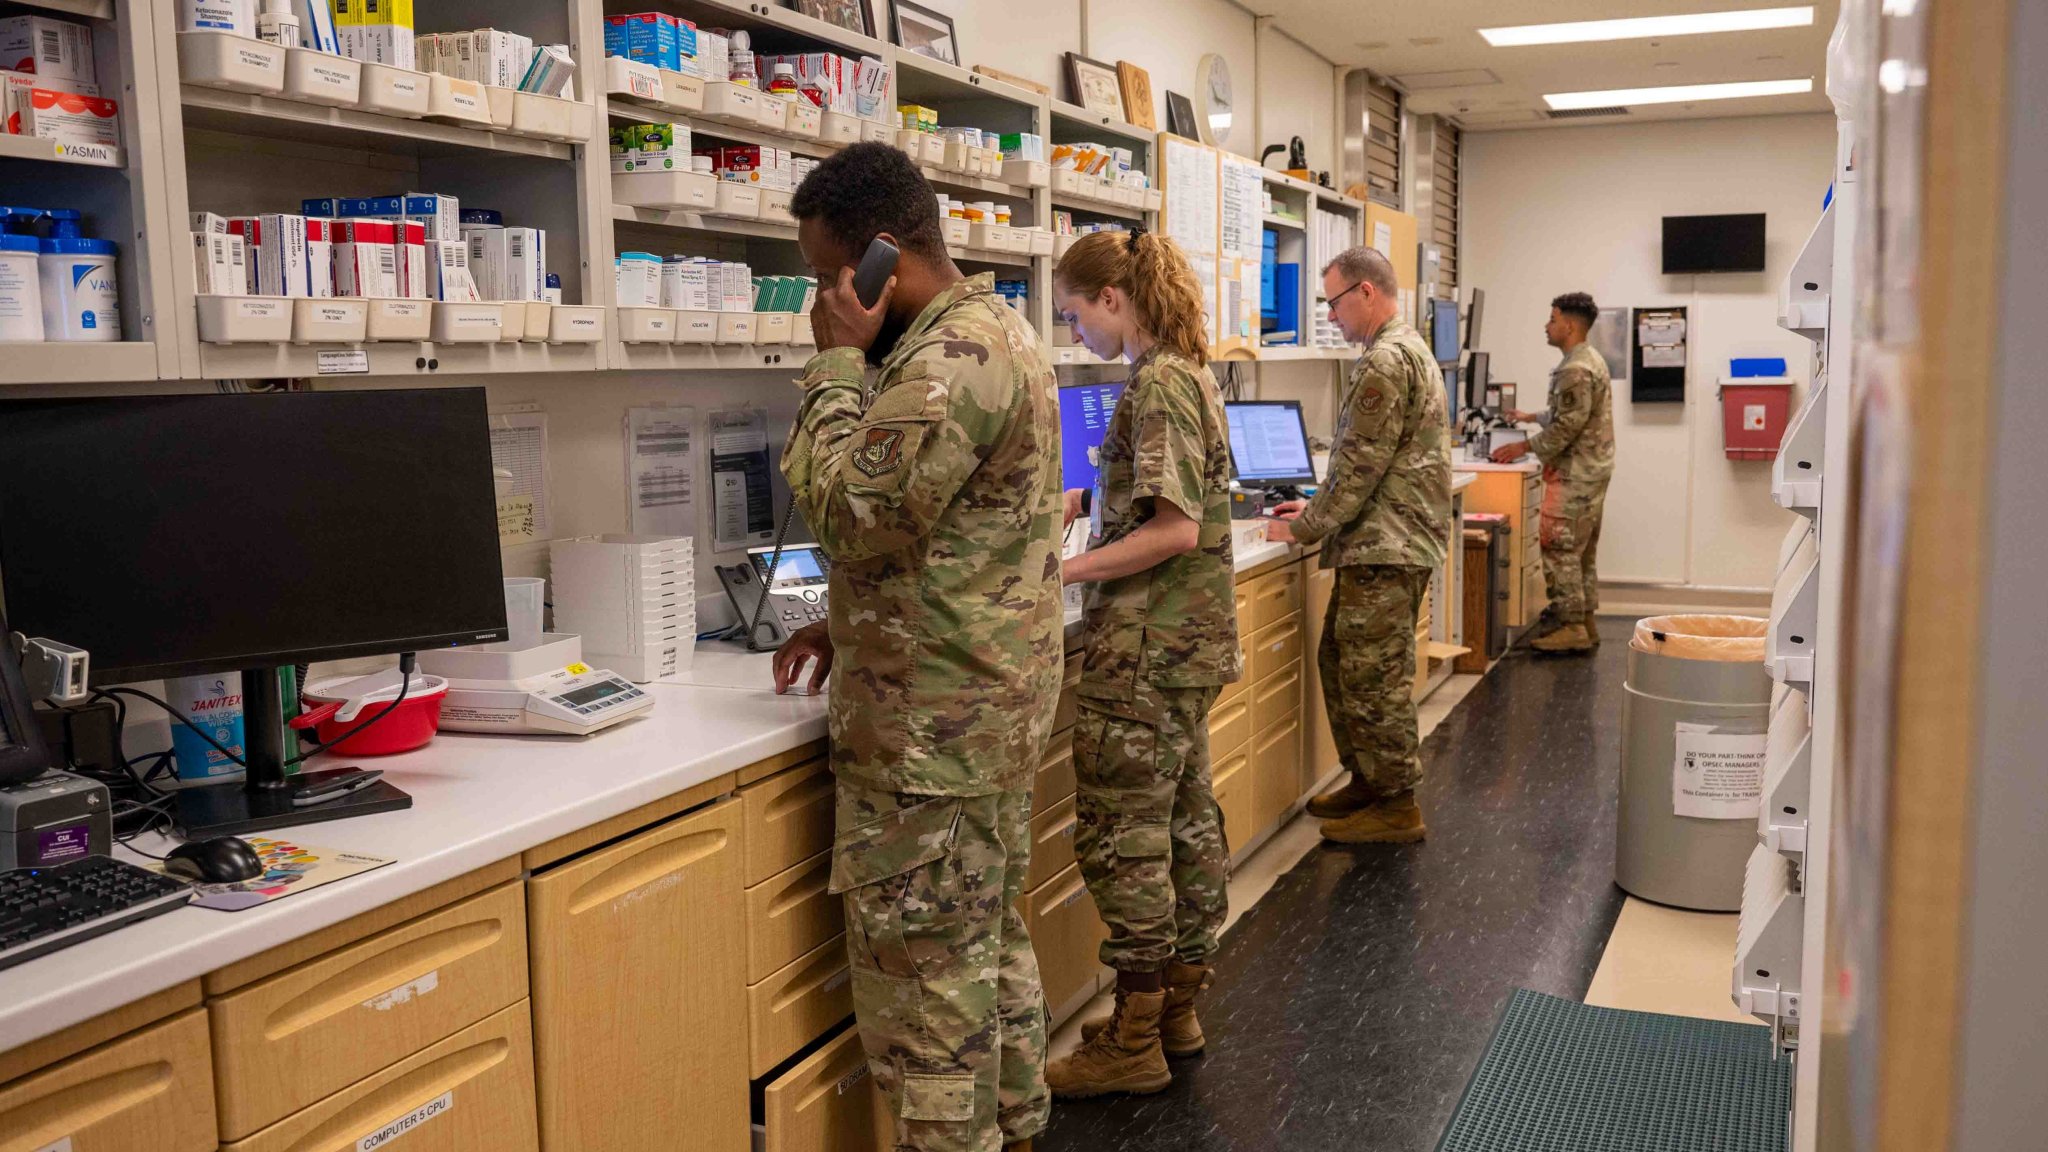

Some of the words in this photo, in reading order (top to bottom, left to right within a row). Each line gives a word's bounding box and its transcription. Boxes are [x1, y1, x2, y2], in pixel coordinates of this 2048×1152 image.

[63, 144, 107, 160] YASMIN
[191, 694, 242, 712] JANITEX
[208, 718, 235, 727] WIPES
[1682, 788, 1694, 796] This
[1694, 790, 1724, 798] Container
[57, 833, 70, 842] CUI
[363, 1115, 418, 1151] COMPUTER
[419, 1110, 426, 1121] 5
[426, 1098, 447, 1117] CPU
